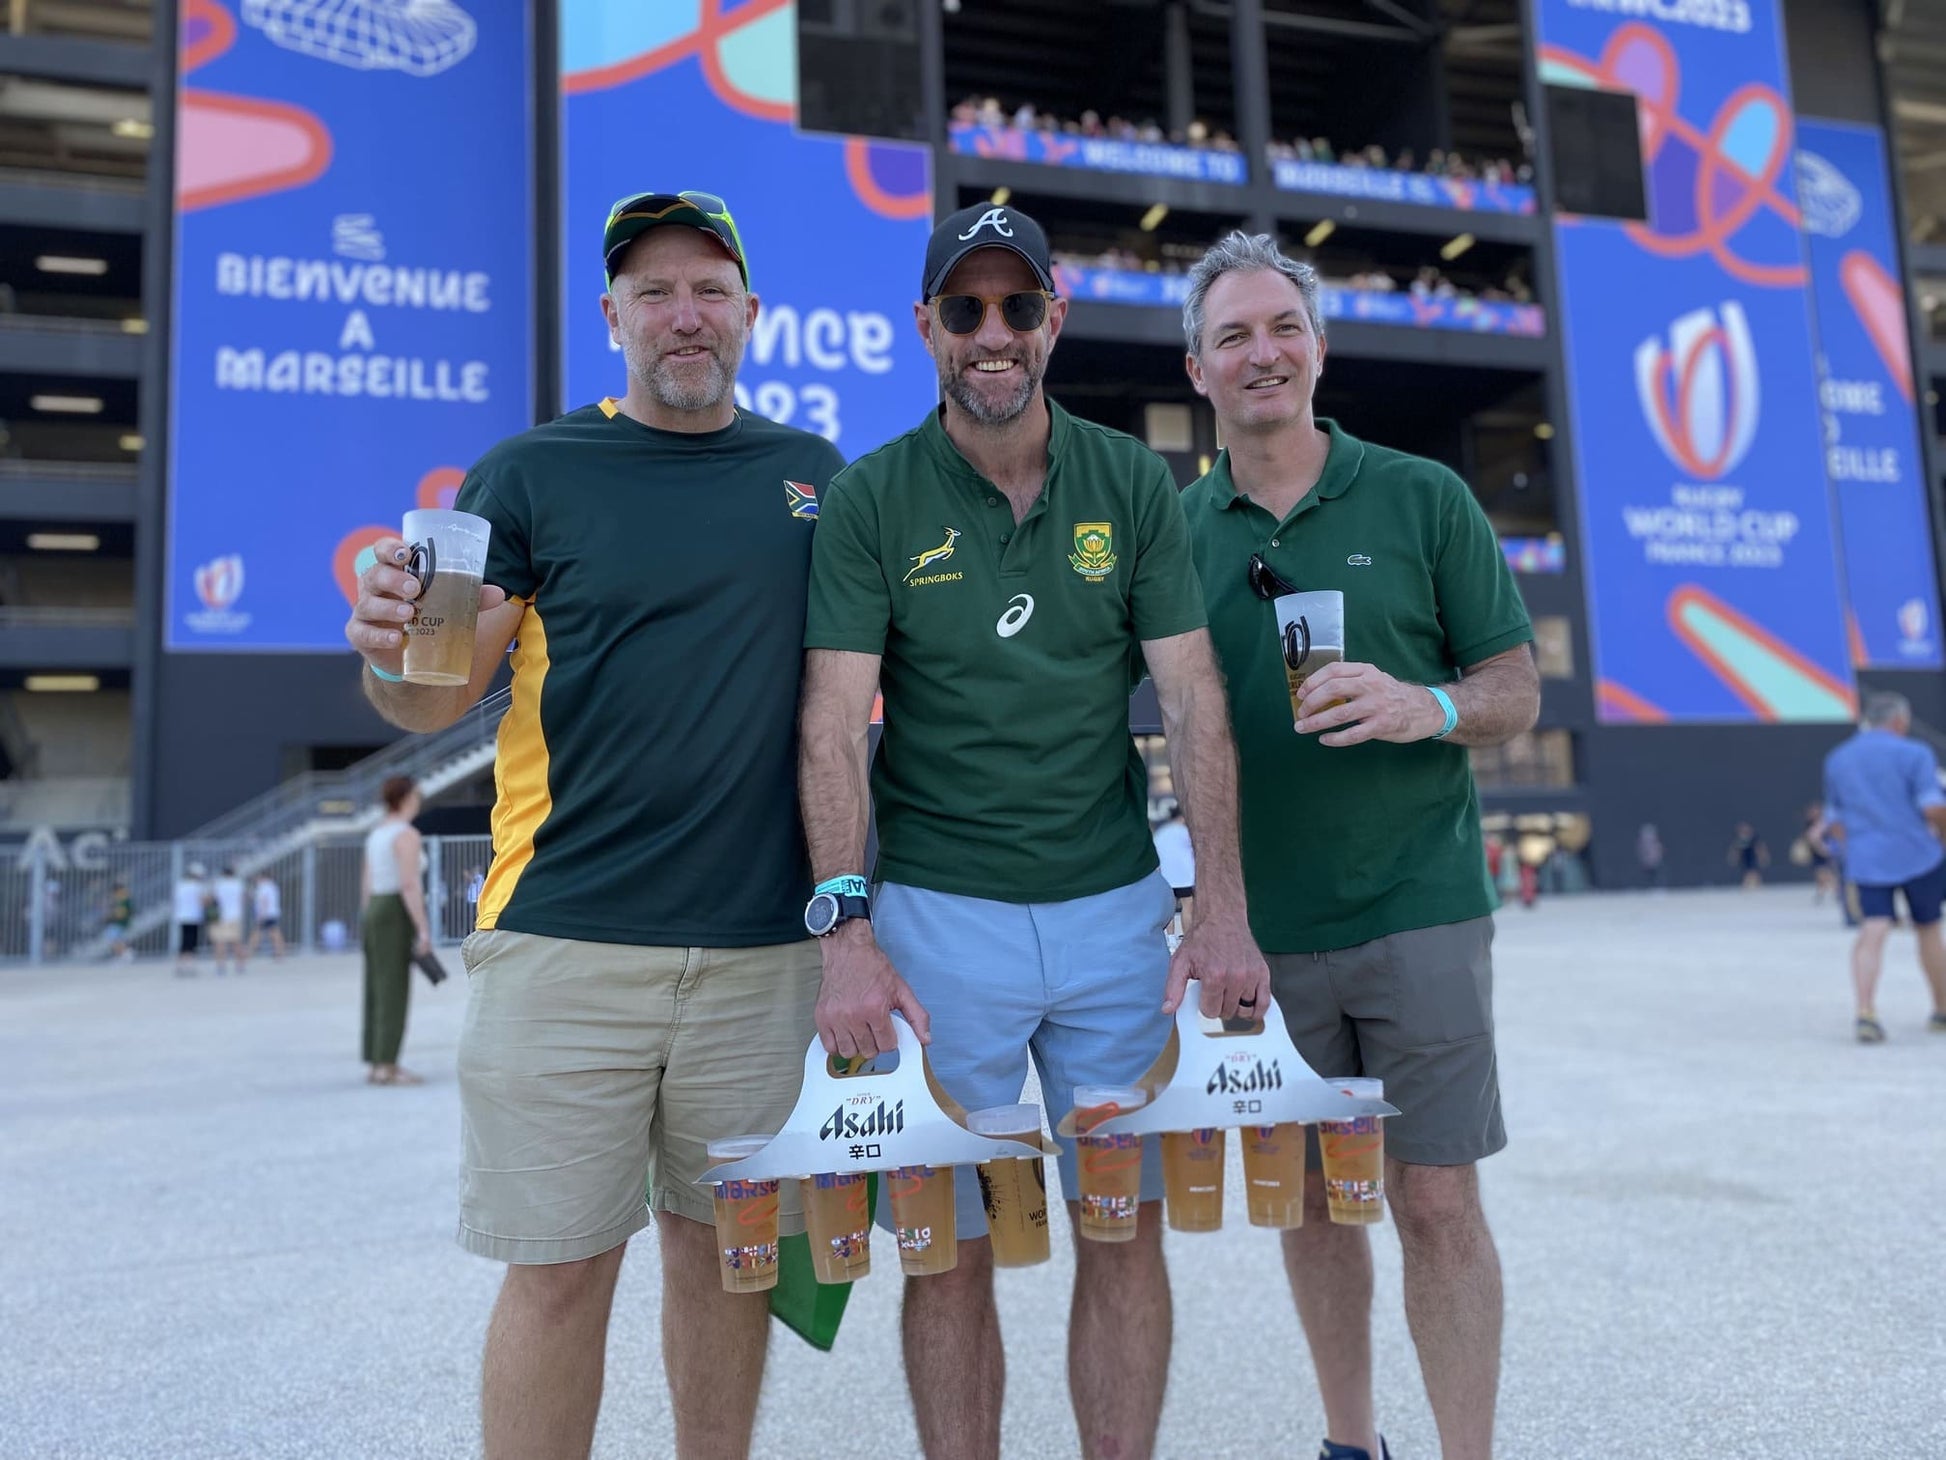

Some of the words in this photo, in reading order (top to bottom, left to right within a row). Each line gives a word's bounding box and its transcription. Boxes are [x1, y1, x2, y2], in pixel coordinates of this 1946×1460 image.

[339, 309, 375, 351] A
[1622, 504, 1738, 541] WORLD
[1740, 509, 1800, 546] CUP
[909, 571, 964, 588] SPRINGBOKS
[421, 616, 445, 628] CUP
[1206, 1058, 1283, 1096] Asahi
[819, 1098, 904, 1142] Asahi
[1232, 1099, 1262, 1115] 辛口
[848, 1143, 882, 1161] 辛口
